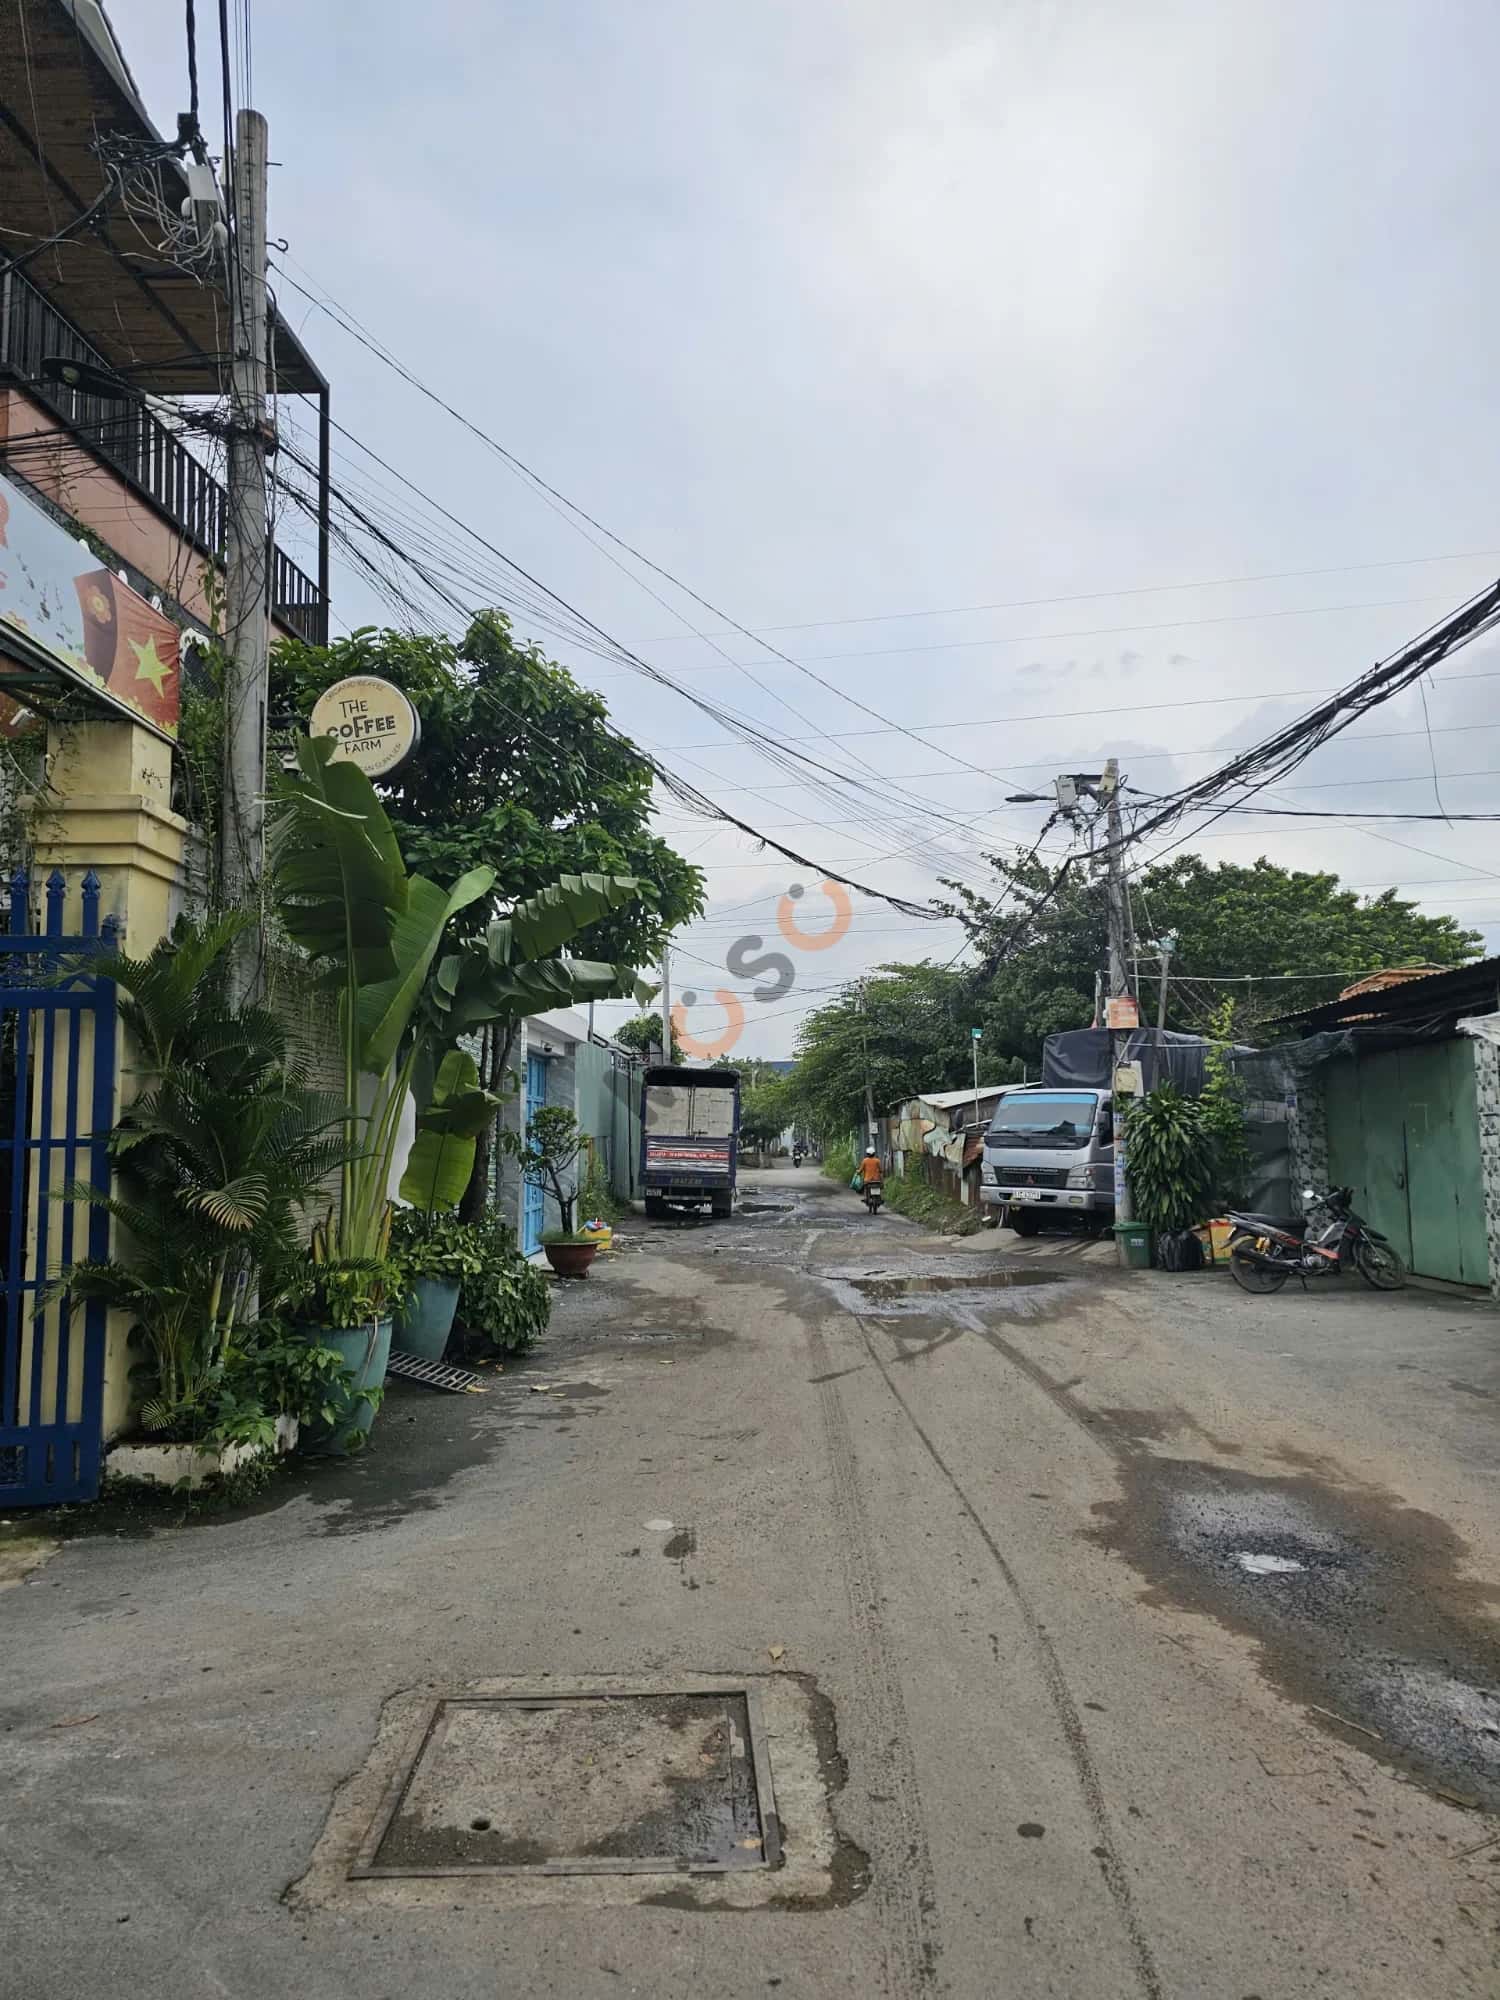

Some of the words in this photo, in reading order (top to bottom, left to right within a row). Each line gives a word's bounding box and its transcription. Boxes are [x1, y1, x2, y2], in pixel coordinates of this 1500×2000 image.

[338, 699, 368, 718] THE
[326, 715, 396, 738] COFFEE
[344, 739, 382, 754] FARM
